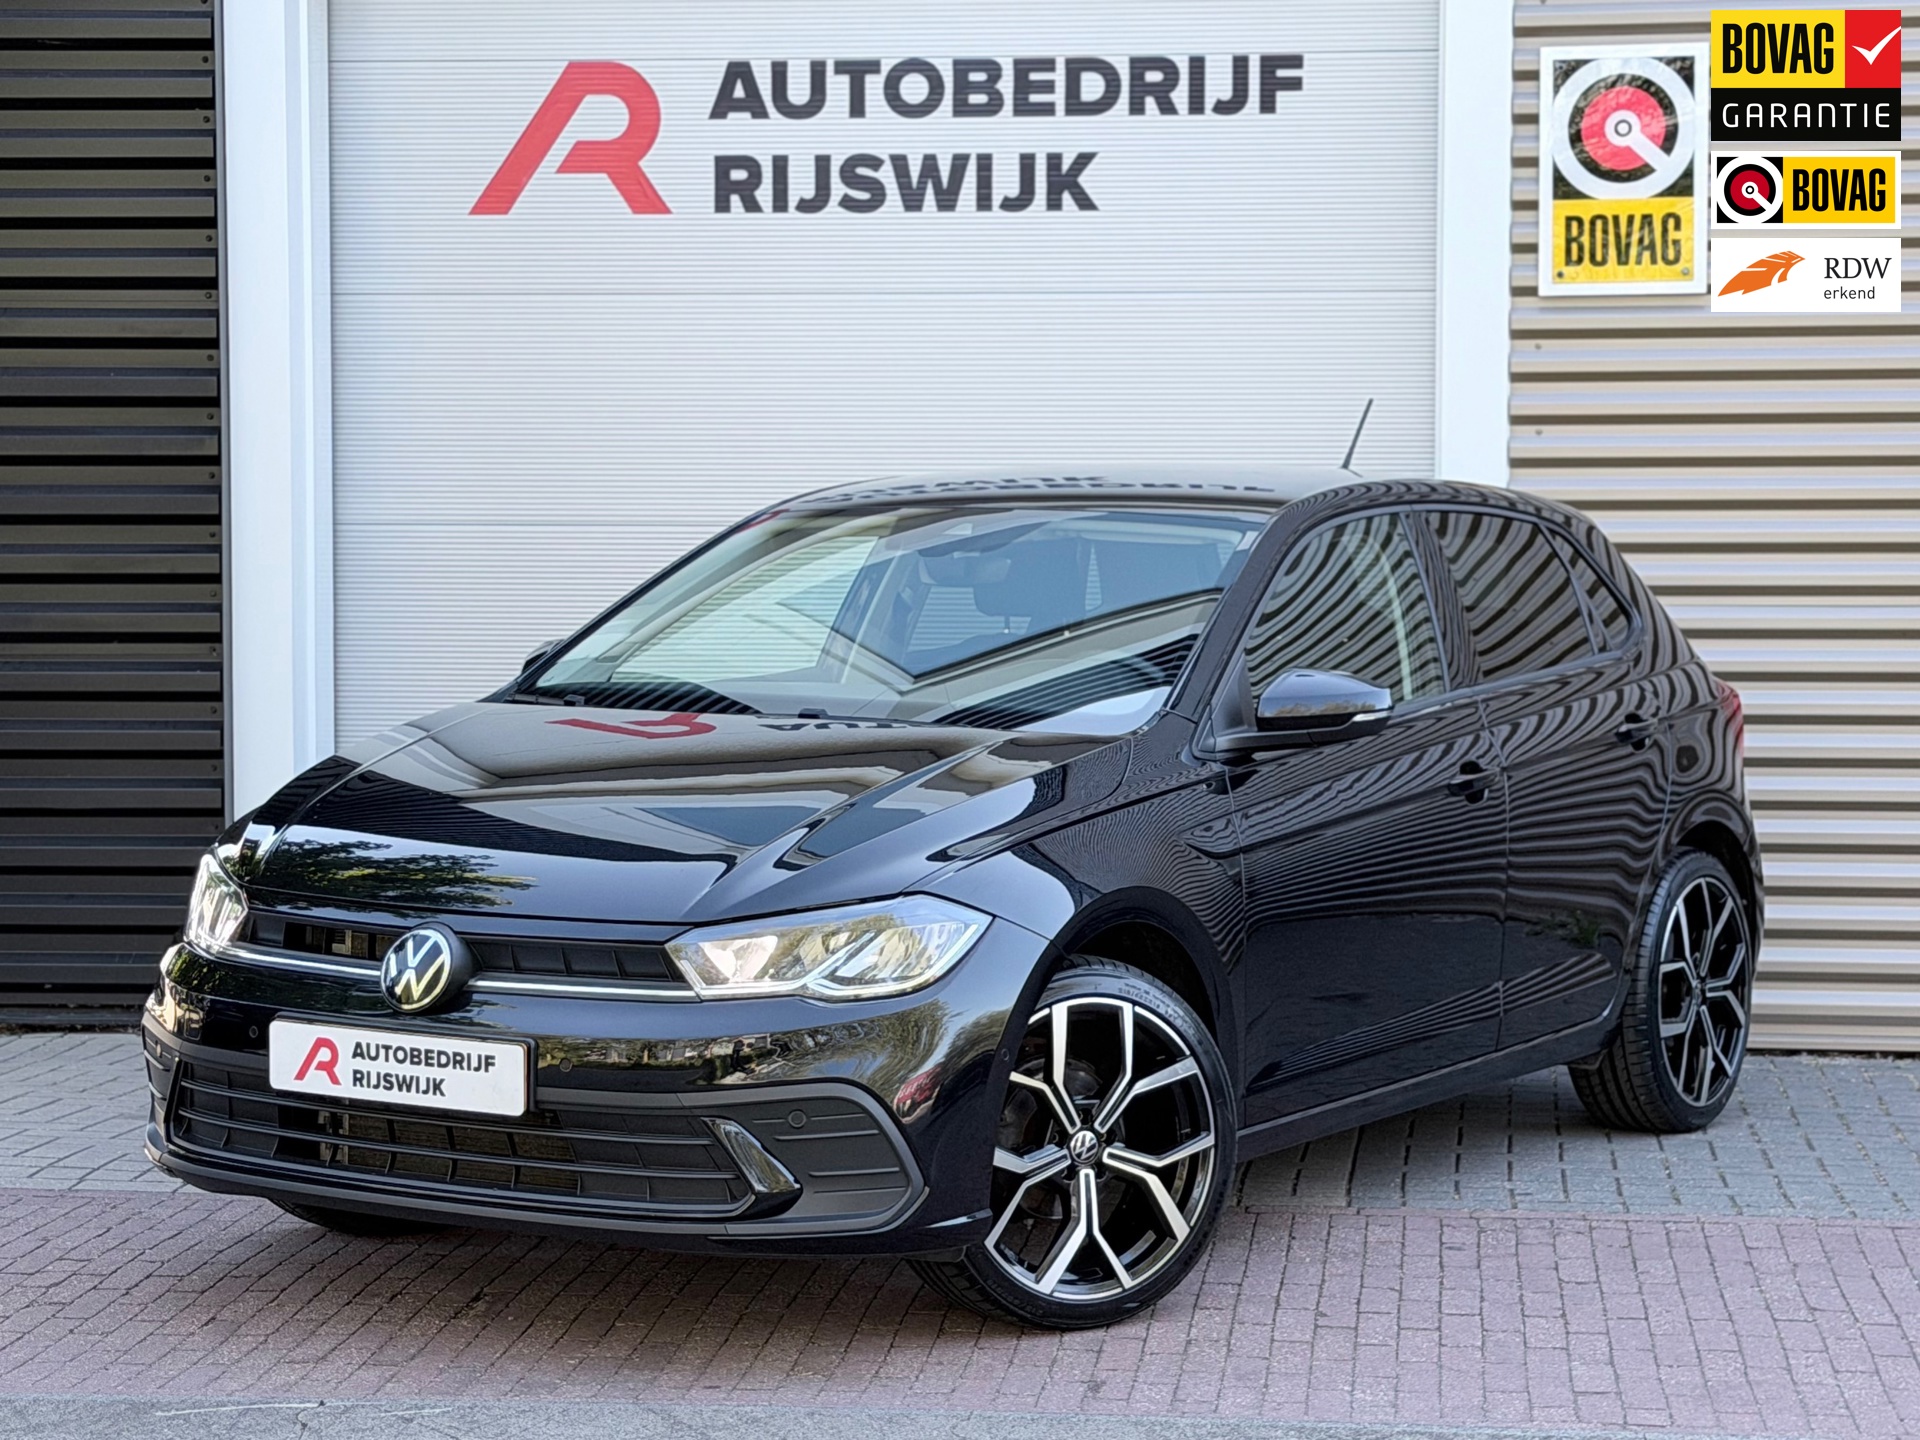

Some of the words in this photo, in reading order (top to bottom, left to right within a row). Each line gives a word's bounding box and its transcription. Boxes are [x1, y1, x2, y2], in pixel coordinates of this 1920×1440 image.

[709, 54, 1304, 119] AUTOBEDRIJF
[713, 152, 1099, 213] RIJSWIJK
[1564, 212, 1682, 267] BOVAG
[351, 1041, 496, 1073] AUTOBEDRIJF
[352, 1069, 446, 1097] RIJSWIJK
